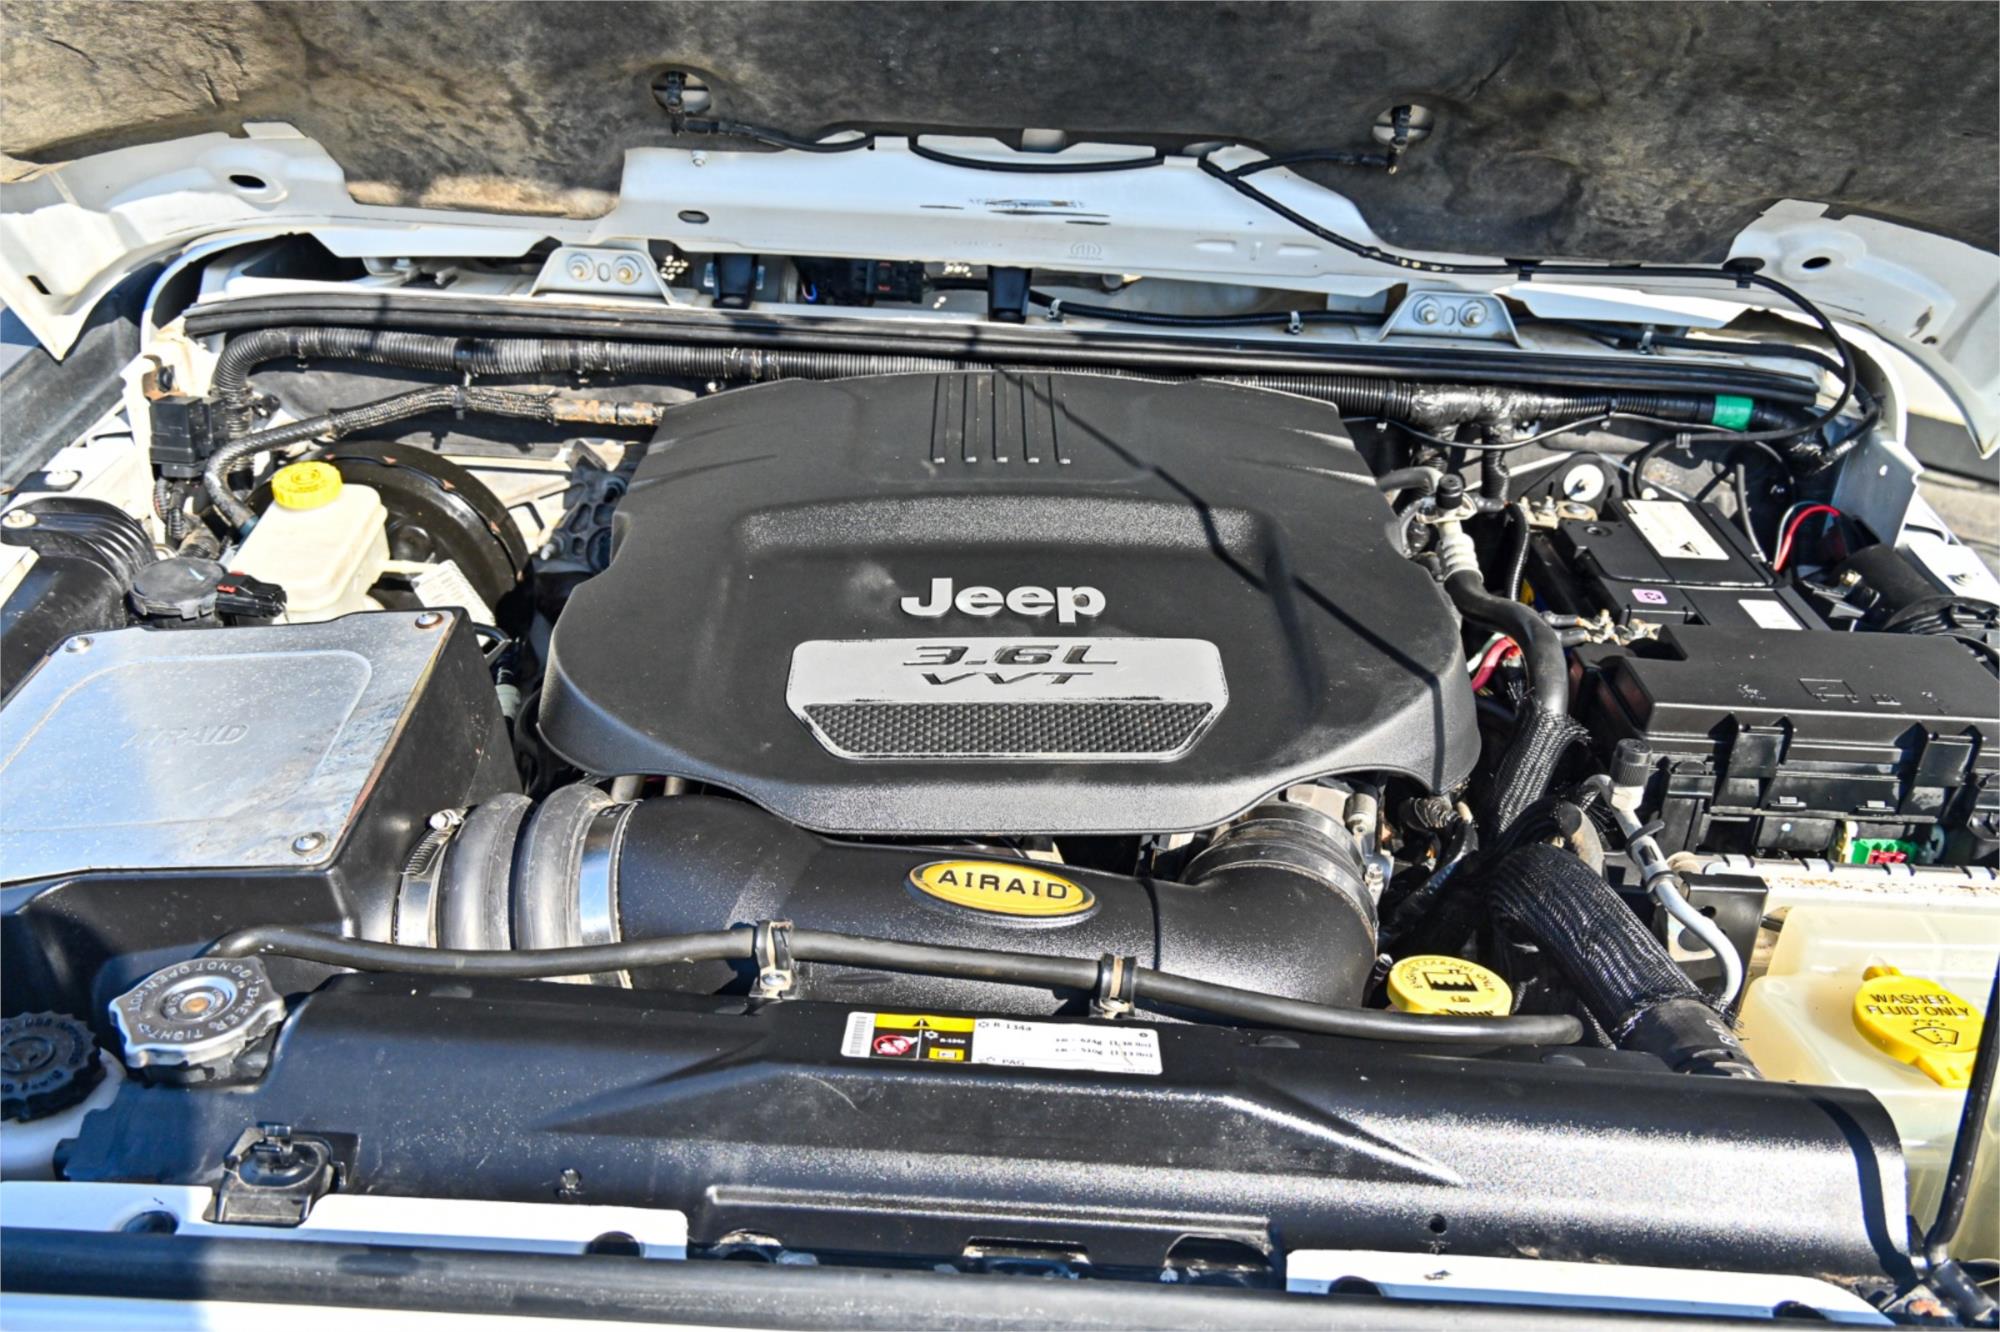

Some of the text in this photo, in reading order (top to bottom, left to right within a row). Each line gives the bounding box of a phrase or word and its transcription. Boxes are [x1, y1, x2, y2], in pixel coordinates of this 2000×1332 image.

[900, 577, 1106, 624] Jeep
[903, 644, 1118, 666] 3.6L
[921, 671, 1094, 686] VVT
[937, 869, 1068, 900] AIRAID
[1869, 993, 1952, 1005] WASHER
[1864, 1004, 1970, 1017] FLUID ONLY
[147, 1028, 205, 1041] TIGHT
